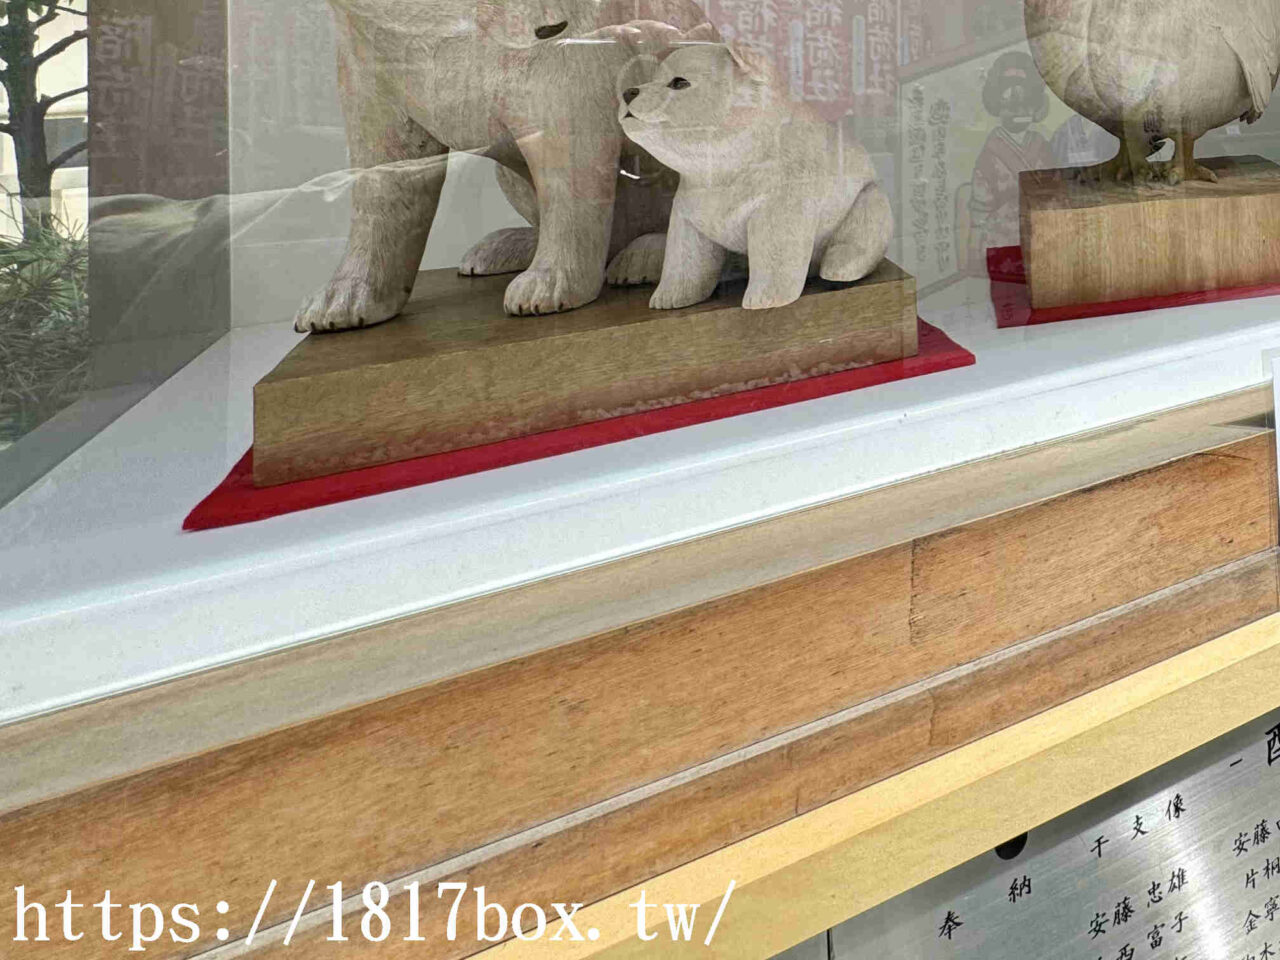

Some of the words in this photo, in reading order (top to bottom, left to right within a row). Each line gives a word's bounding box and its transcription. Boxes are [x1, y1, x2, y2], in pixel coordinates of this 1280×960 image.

[1245, 856, 1280, 890] 片桐
[1087, 896, 1135, 940] 安藤
[1147, 867, 1188, 908] 忠雄
